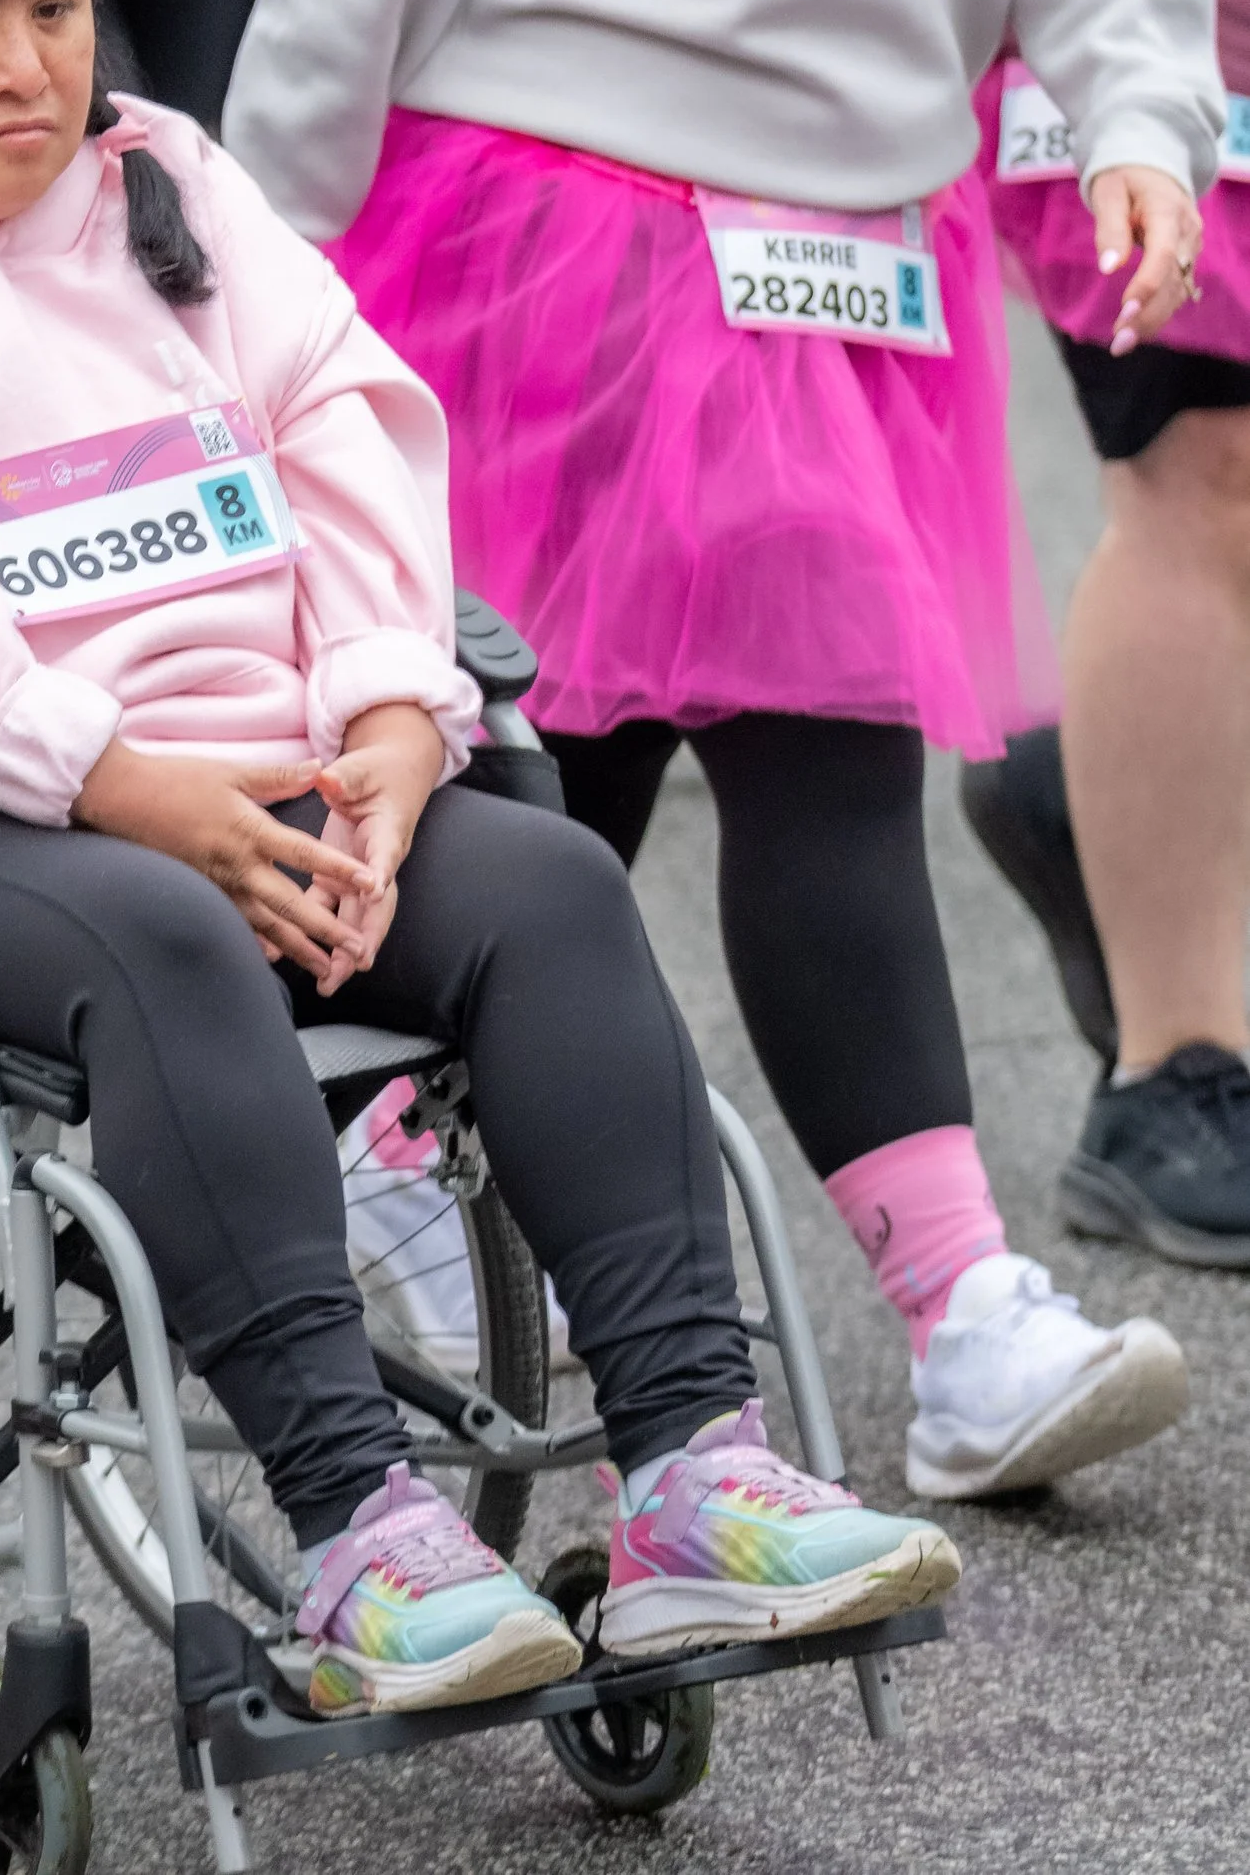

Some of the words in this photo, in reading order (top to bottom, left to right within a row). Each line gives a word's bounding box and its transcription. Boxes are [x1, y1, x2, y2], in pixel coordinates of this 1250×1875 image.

[763, 237, 857, 270] KERRIE
[904, 267, 917, 297] 8
[731, 274, 888, 328] 282403
[215, 484, 246, 518] 8
[223, 518, 265, 547] KM
